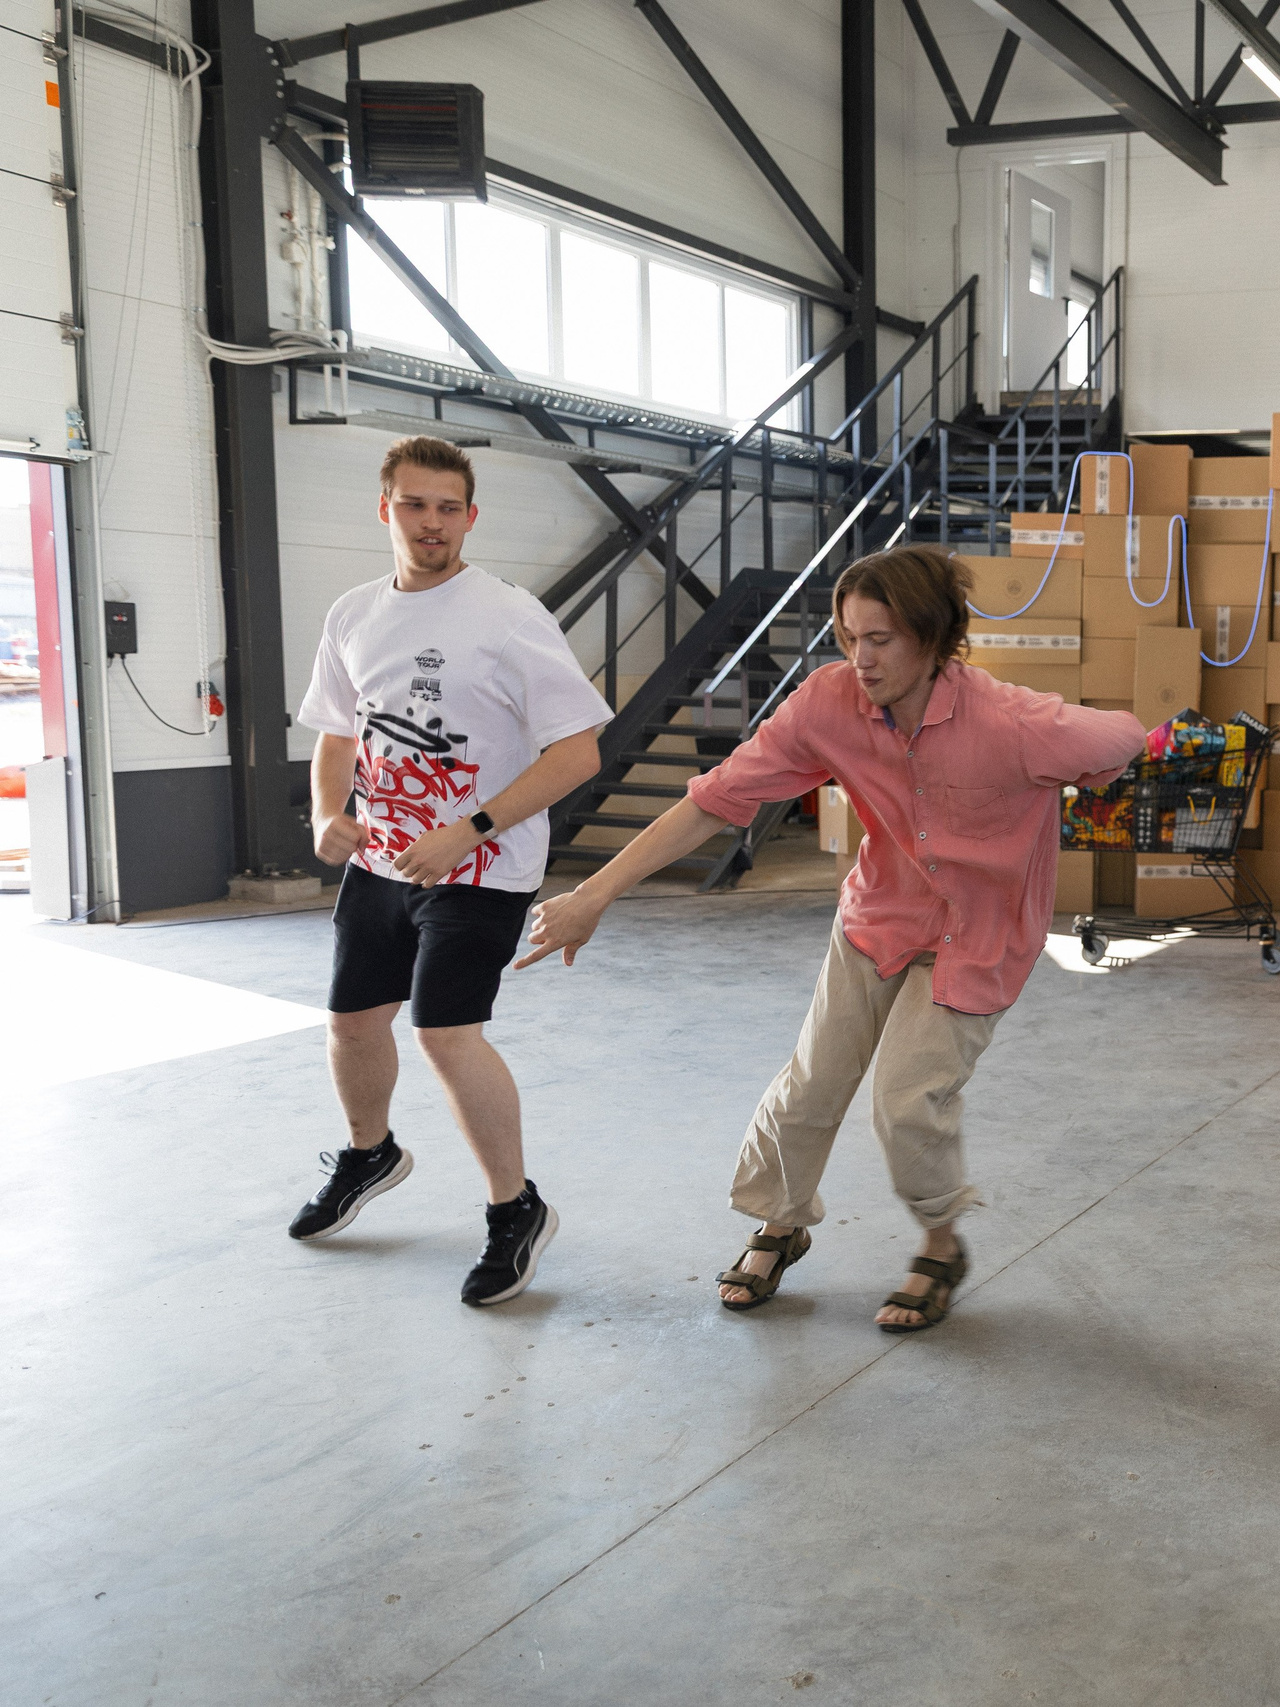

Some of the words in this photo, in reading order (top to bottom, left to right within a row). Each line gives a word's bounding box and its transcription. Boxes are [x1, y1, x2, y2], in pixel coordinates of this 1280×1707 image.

[414, 655, 446, 665] WORLD
[417, 661, 440, 669] TOUR
[1240, 712, 1270, 735] SMART
